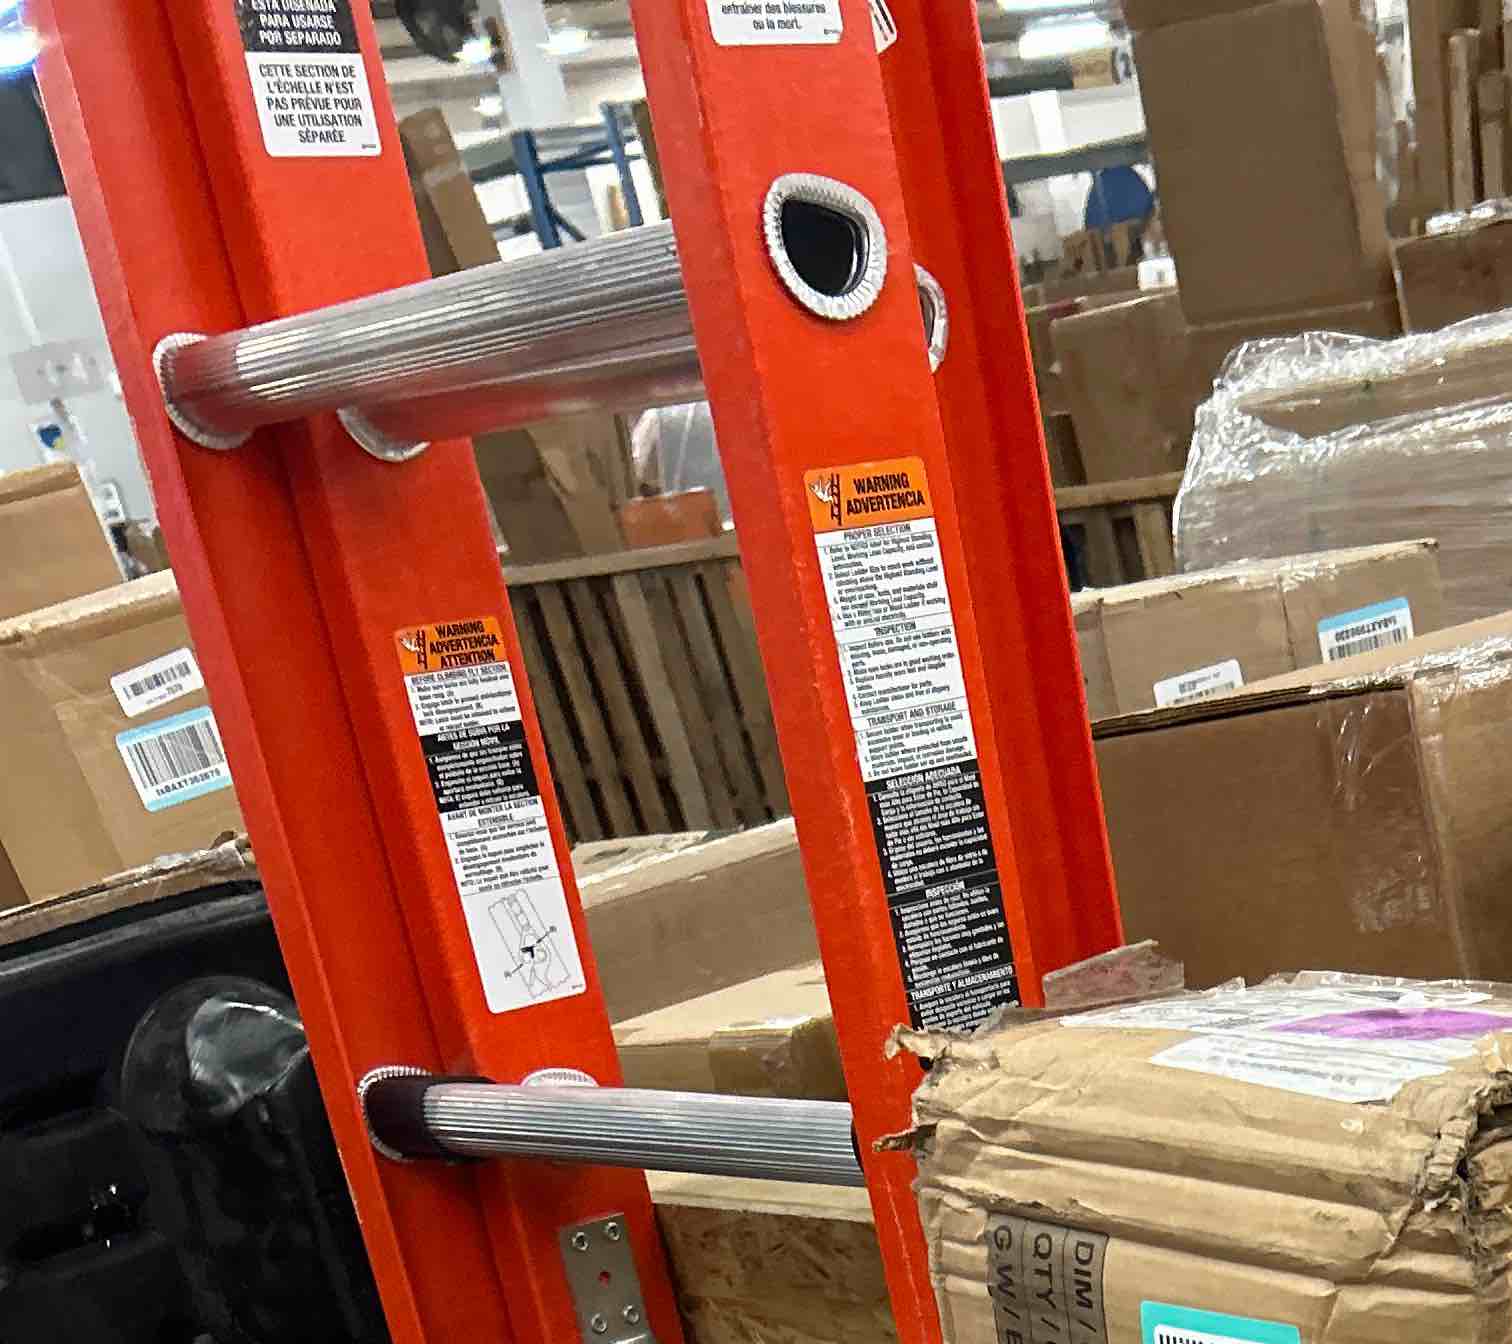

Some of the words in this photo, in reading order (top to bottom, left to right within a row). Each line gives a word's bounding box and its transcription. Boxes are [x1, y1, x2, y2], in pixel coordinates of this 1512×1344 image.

[284, 31, 342, 46] SEPARADO
[260, 64, 293, 78] CETTE
[295, 64, 339, 78] SECTION
[342, 65, 356, 78] DE
[267, 79, 321, 94] L'ÉCHELLE
[325, 81, 354, 95] N'EST
[266, 97, 289, 110] PAS
[291, 95, 333, 110] PRÉVUE
[334, 98, 362, 110] POUR
[274, 114, 296, 127] UNE
[298, 114, 362, 127] UTILISATION
[853, 472, 910, 494] WARNING
[846, 490, 926, 515] ADVERTENCIA
[435, 621, 485, 639] WARNING
[429, 633, 500, 655] ADVERTENCIA
[440, 648, 496, 669] ATTENTION
[1032, 1232, 1057, 1310] QTY
[1073, 1240, 1095, 1310] DIM
